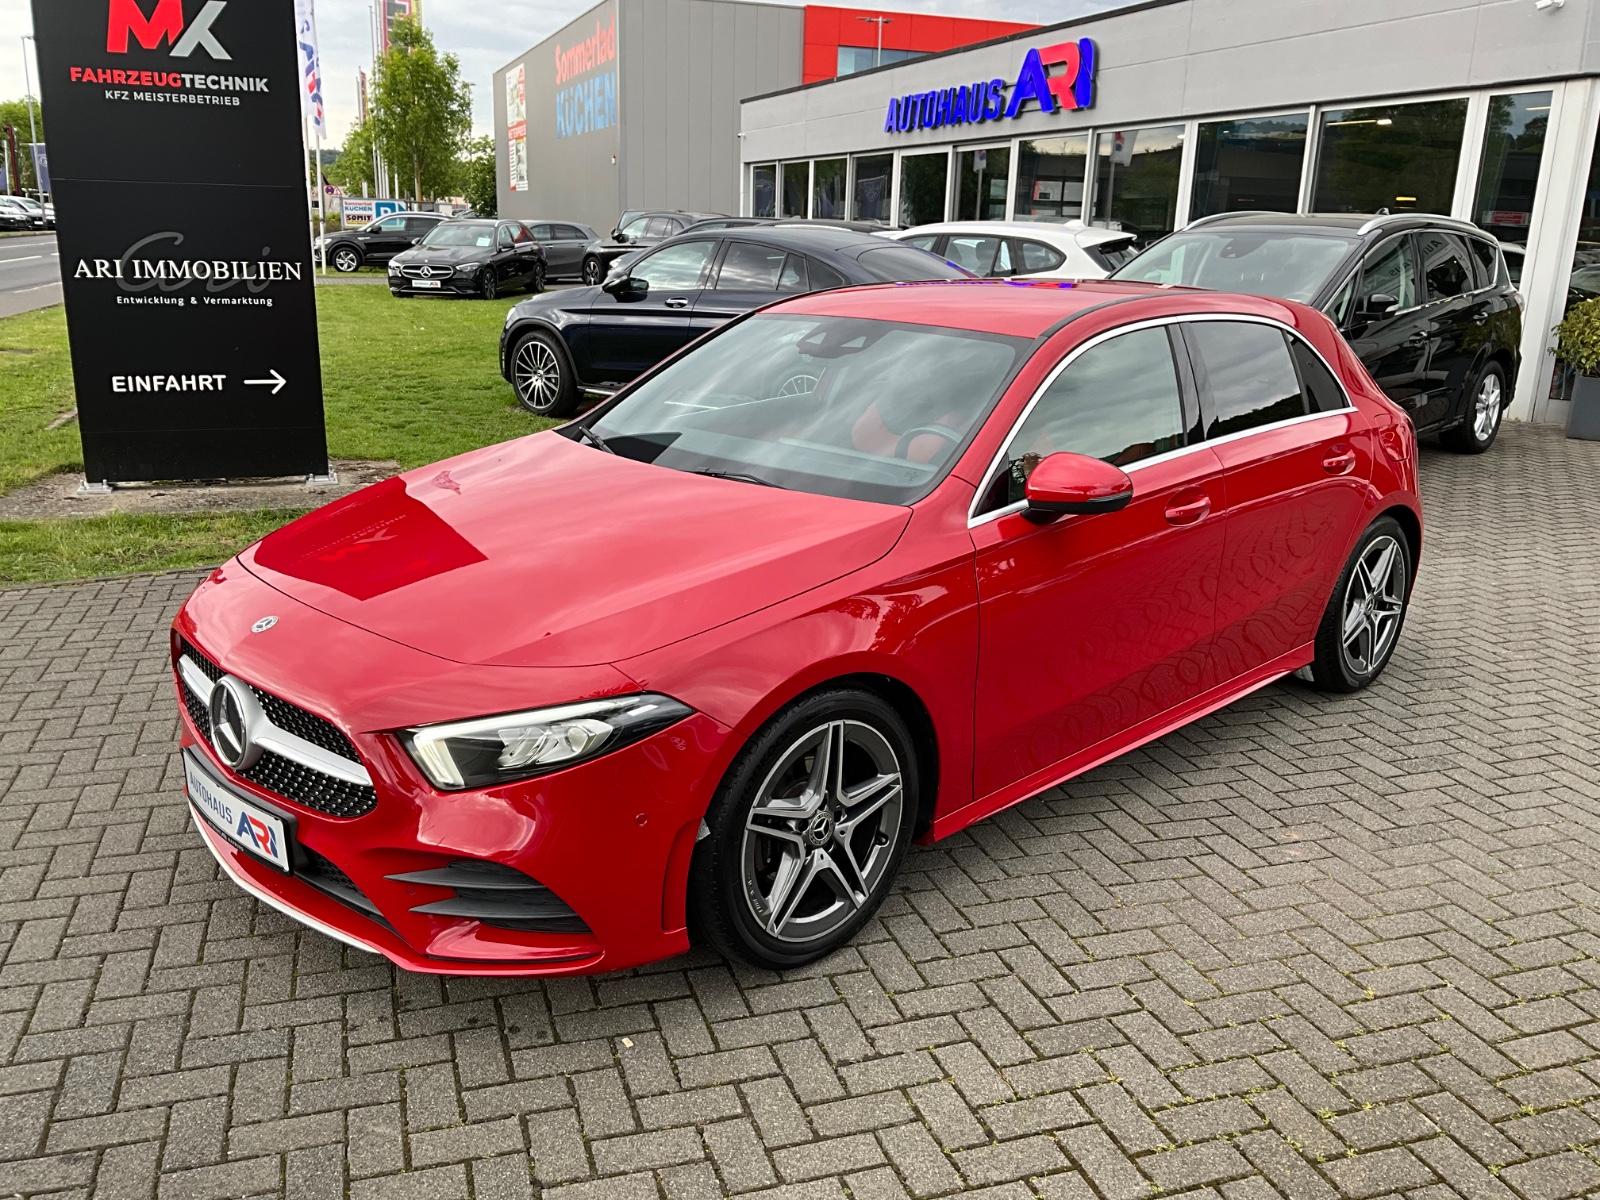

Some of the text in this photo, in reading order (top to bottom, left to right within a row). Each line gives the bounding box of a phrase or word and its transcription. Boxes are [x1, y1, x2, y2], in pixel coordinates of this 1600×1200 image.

[69, 66, 270, 93] FAHRZEUGTECHNIK
[884, 37, 1095, 134] AUTOHAUS ARI
[104, 90, 241, 106] KFZ MEISTERBETRIEB
[74, 258, 302, 281] ARI IMMOBILIEN
[116, 296, 273, 307] Entwicklung & Vermarktung
[111, 374, 227, 393] EINFAHRT
[189, 770, 233, 825] AUTOHAUS
[236, 811, 279, 859] ARI
